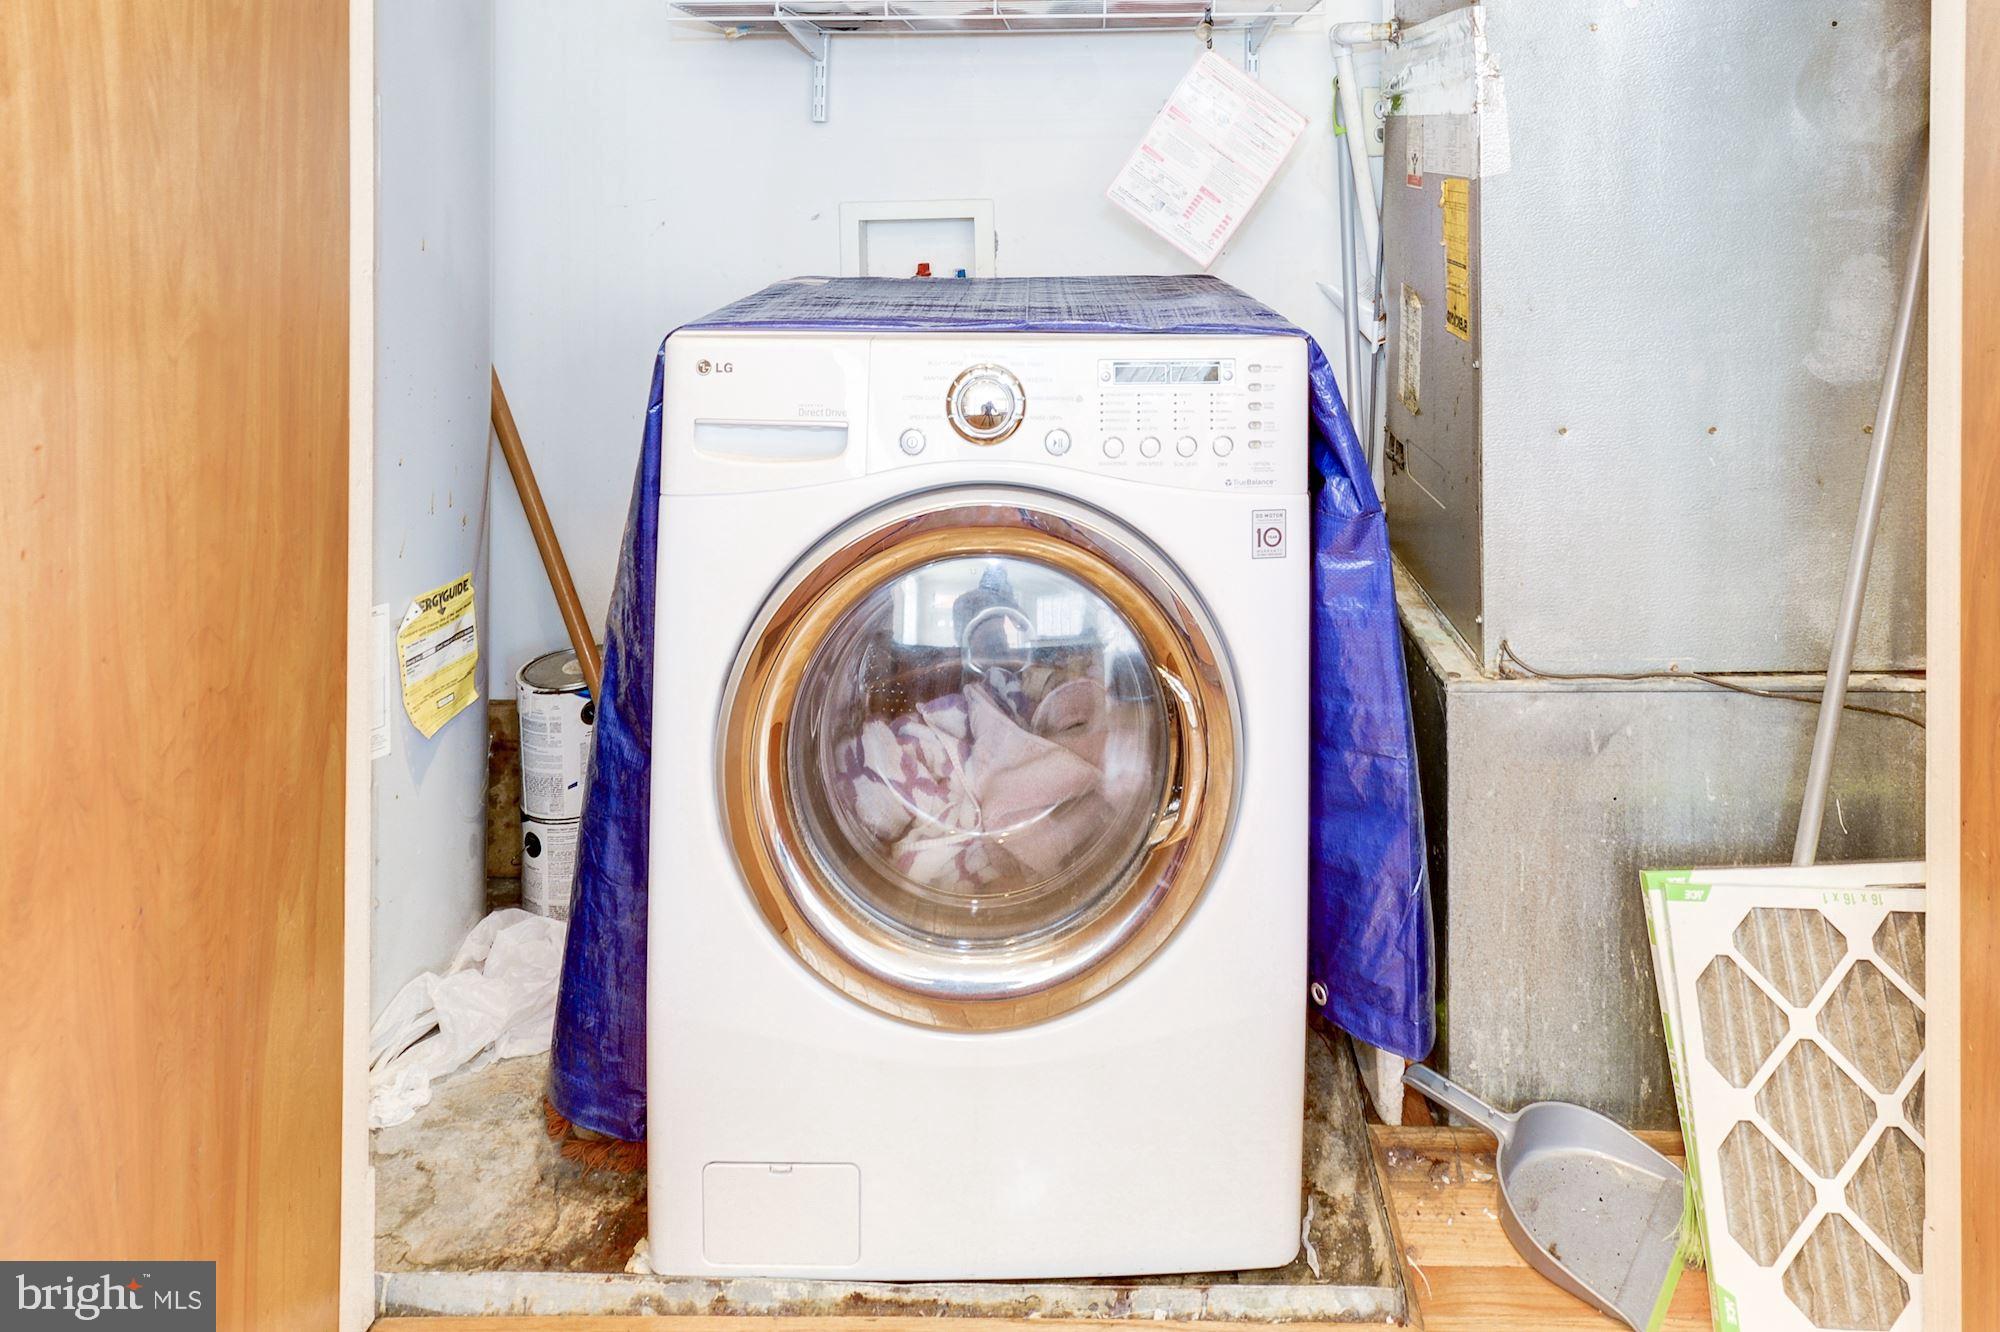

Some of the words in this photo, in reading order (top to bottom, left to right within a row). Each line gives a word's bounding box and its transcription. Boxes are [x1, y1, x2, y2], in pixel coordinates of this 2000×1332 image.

[715, 362, 733, 373] LG
[799, 408, 824, 417] Direct
[826, 408, 848, 417] Drive
[1256, 527, 1282, 547] 10
[1842, 892, 1856, 906] 16
[1871, 892, 1884, 906] 16
